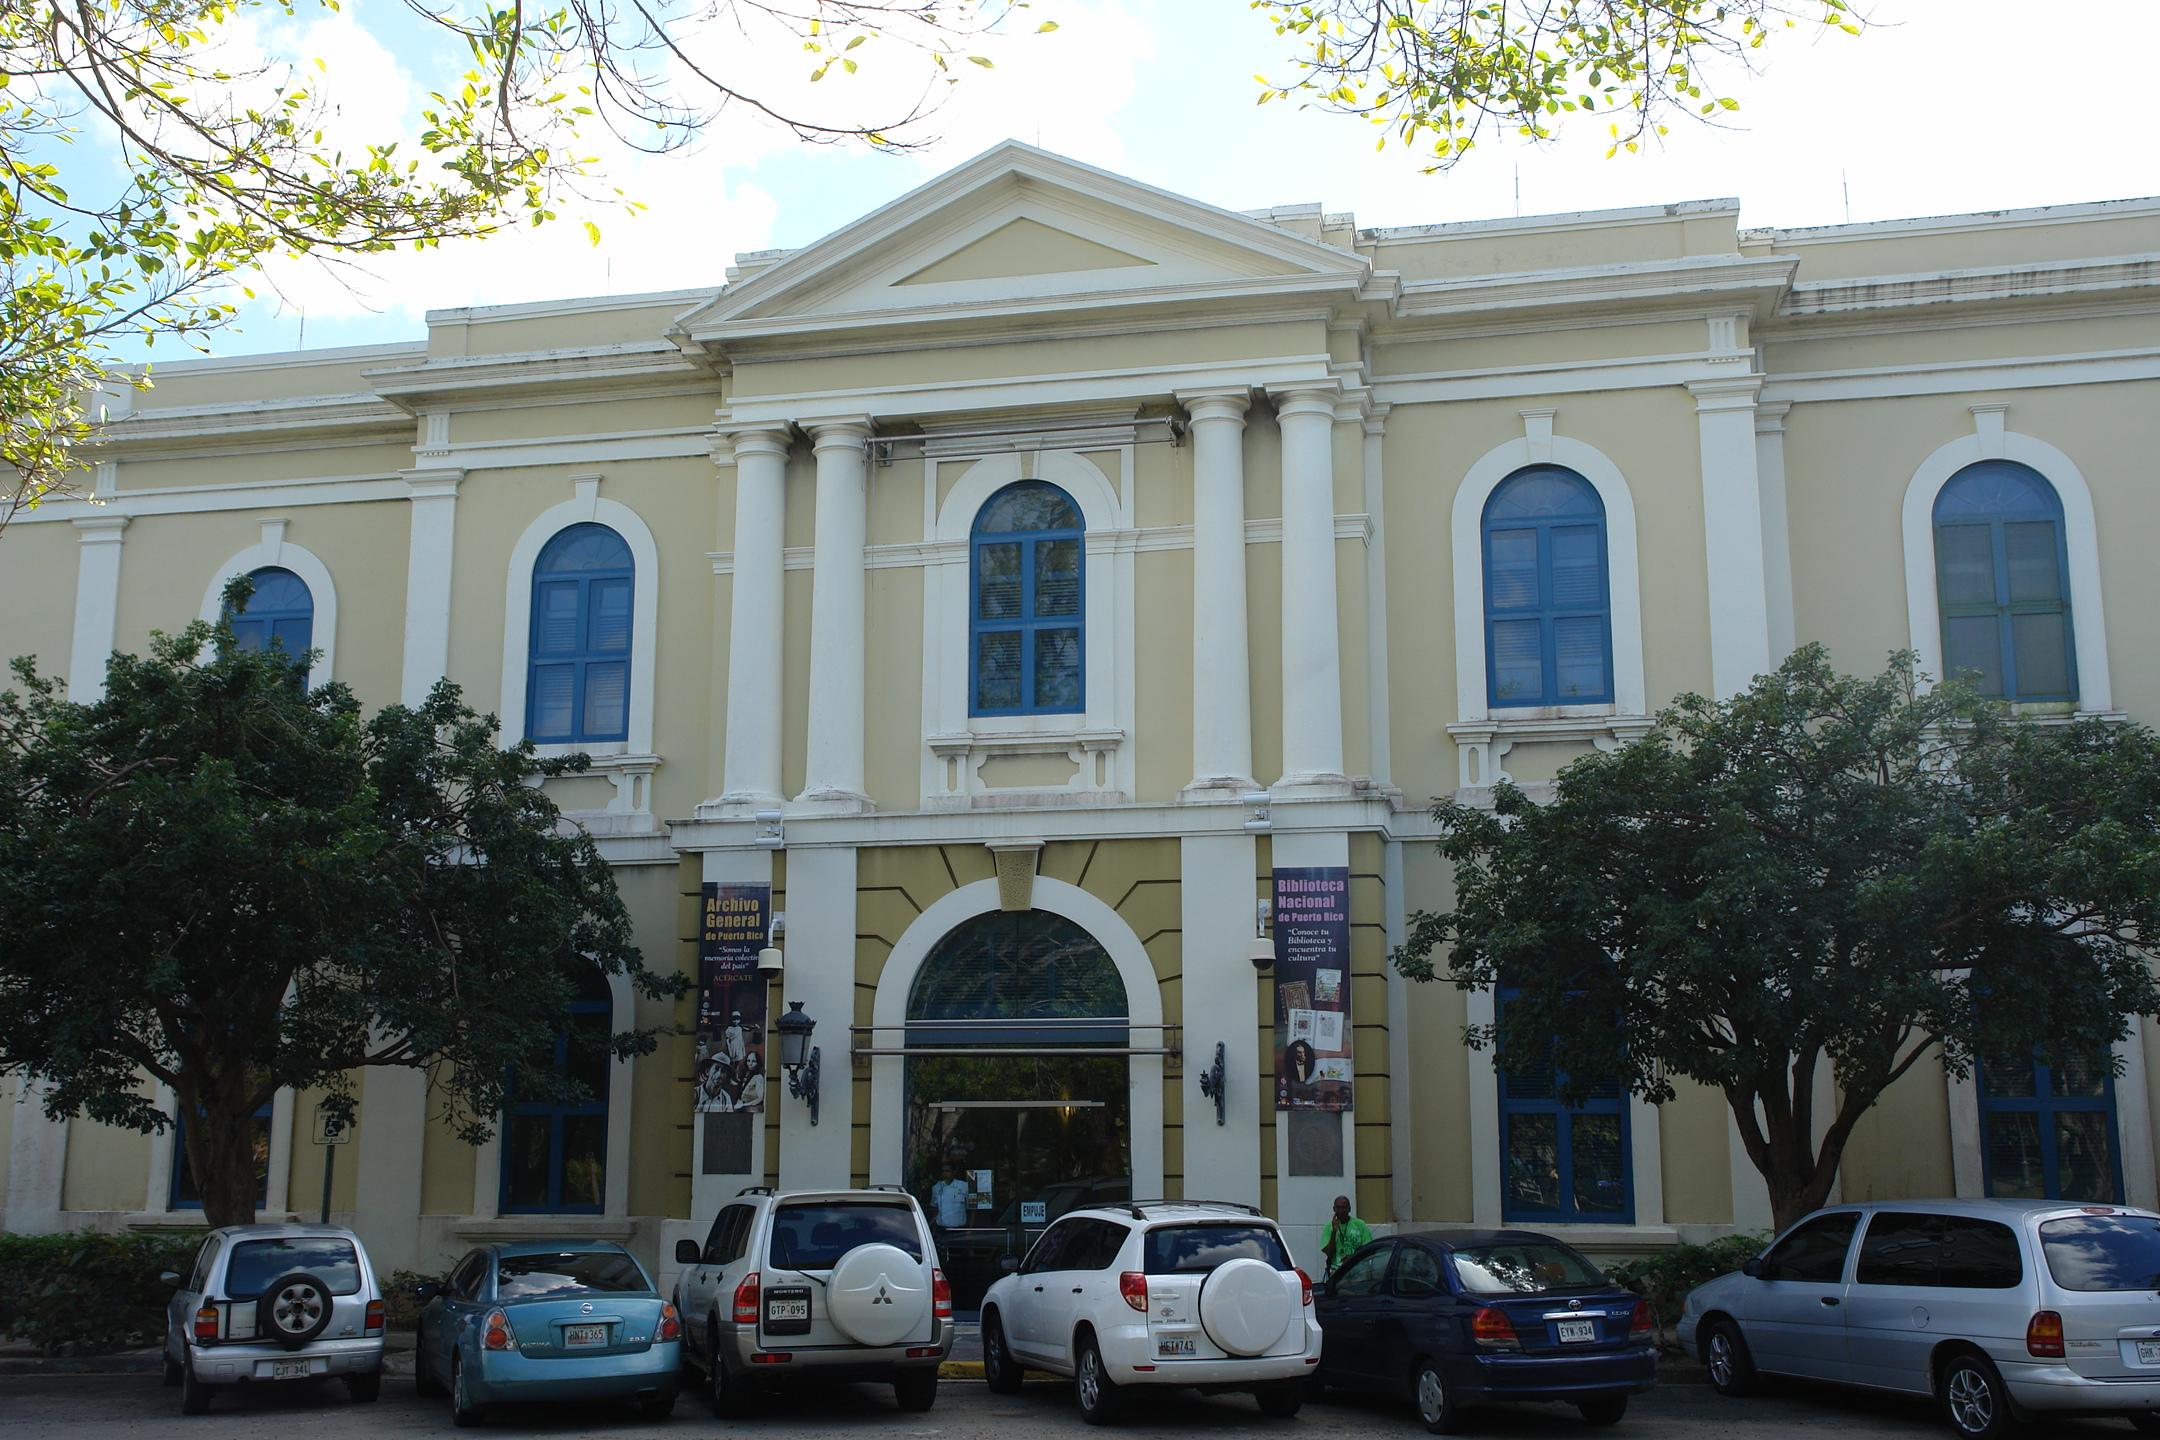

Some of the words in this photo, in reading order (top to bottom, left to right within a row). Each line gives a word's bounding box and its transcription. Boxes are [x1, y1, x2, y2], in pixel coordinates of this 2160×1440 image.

[1278, 879, 1344, 893] Biblioteca
[706, 898, 759, 912] Archivo
[1278, 895, 1335, 908] Nacional
[706, 913, 760, 928] General
[1278, 912, 1290, 922] de
[1291, 912, 1322, 922] Puerto
[1323, 911, 1344, 921] Rico
[705, 932, 716, 940] de
[718, 932, 745, 940] Puerto
[746, 931, 764, 940] Rico
[1288, 936, 1326, 944] Biblioteca
[743, 945, 750, 953] la
